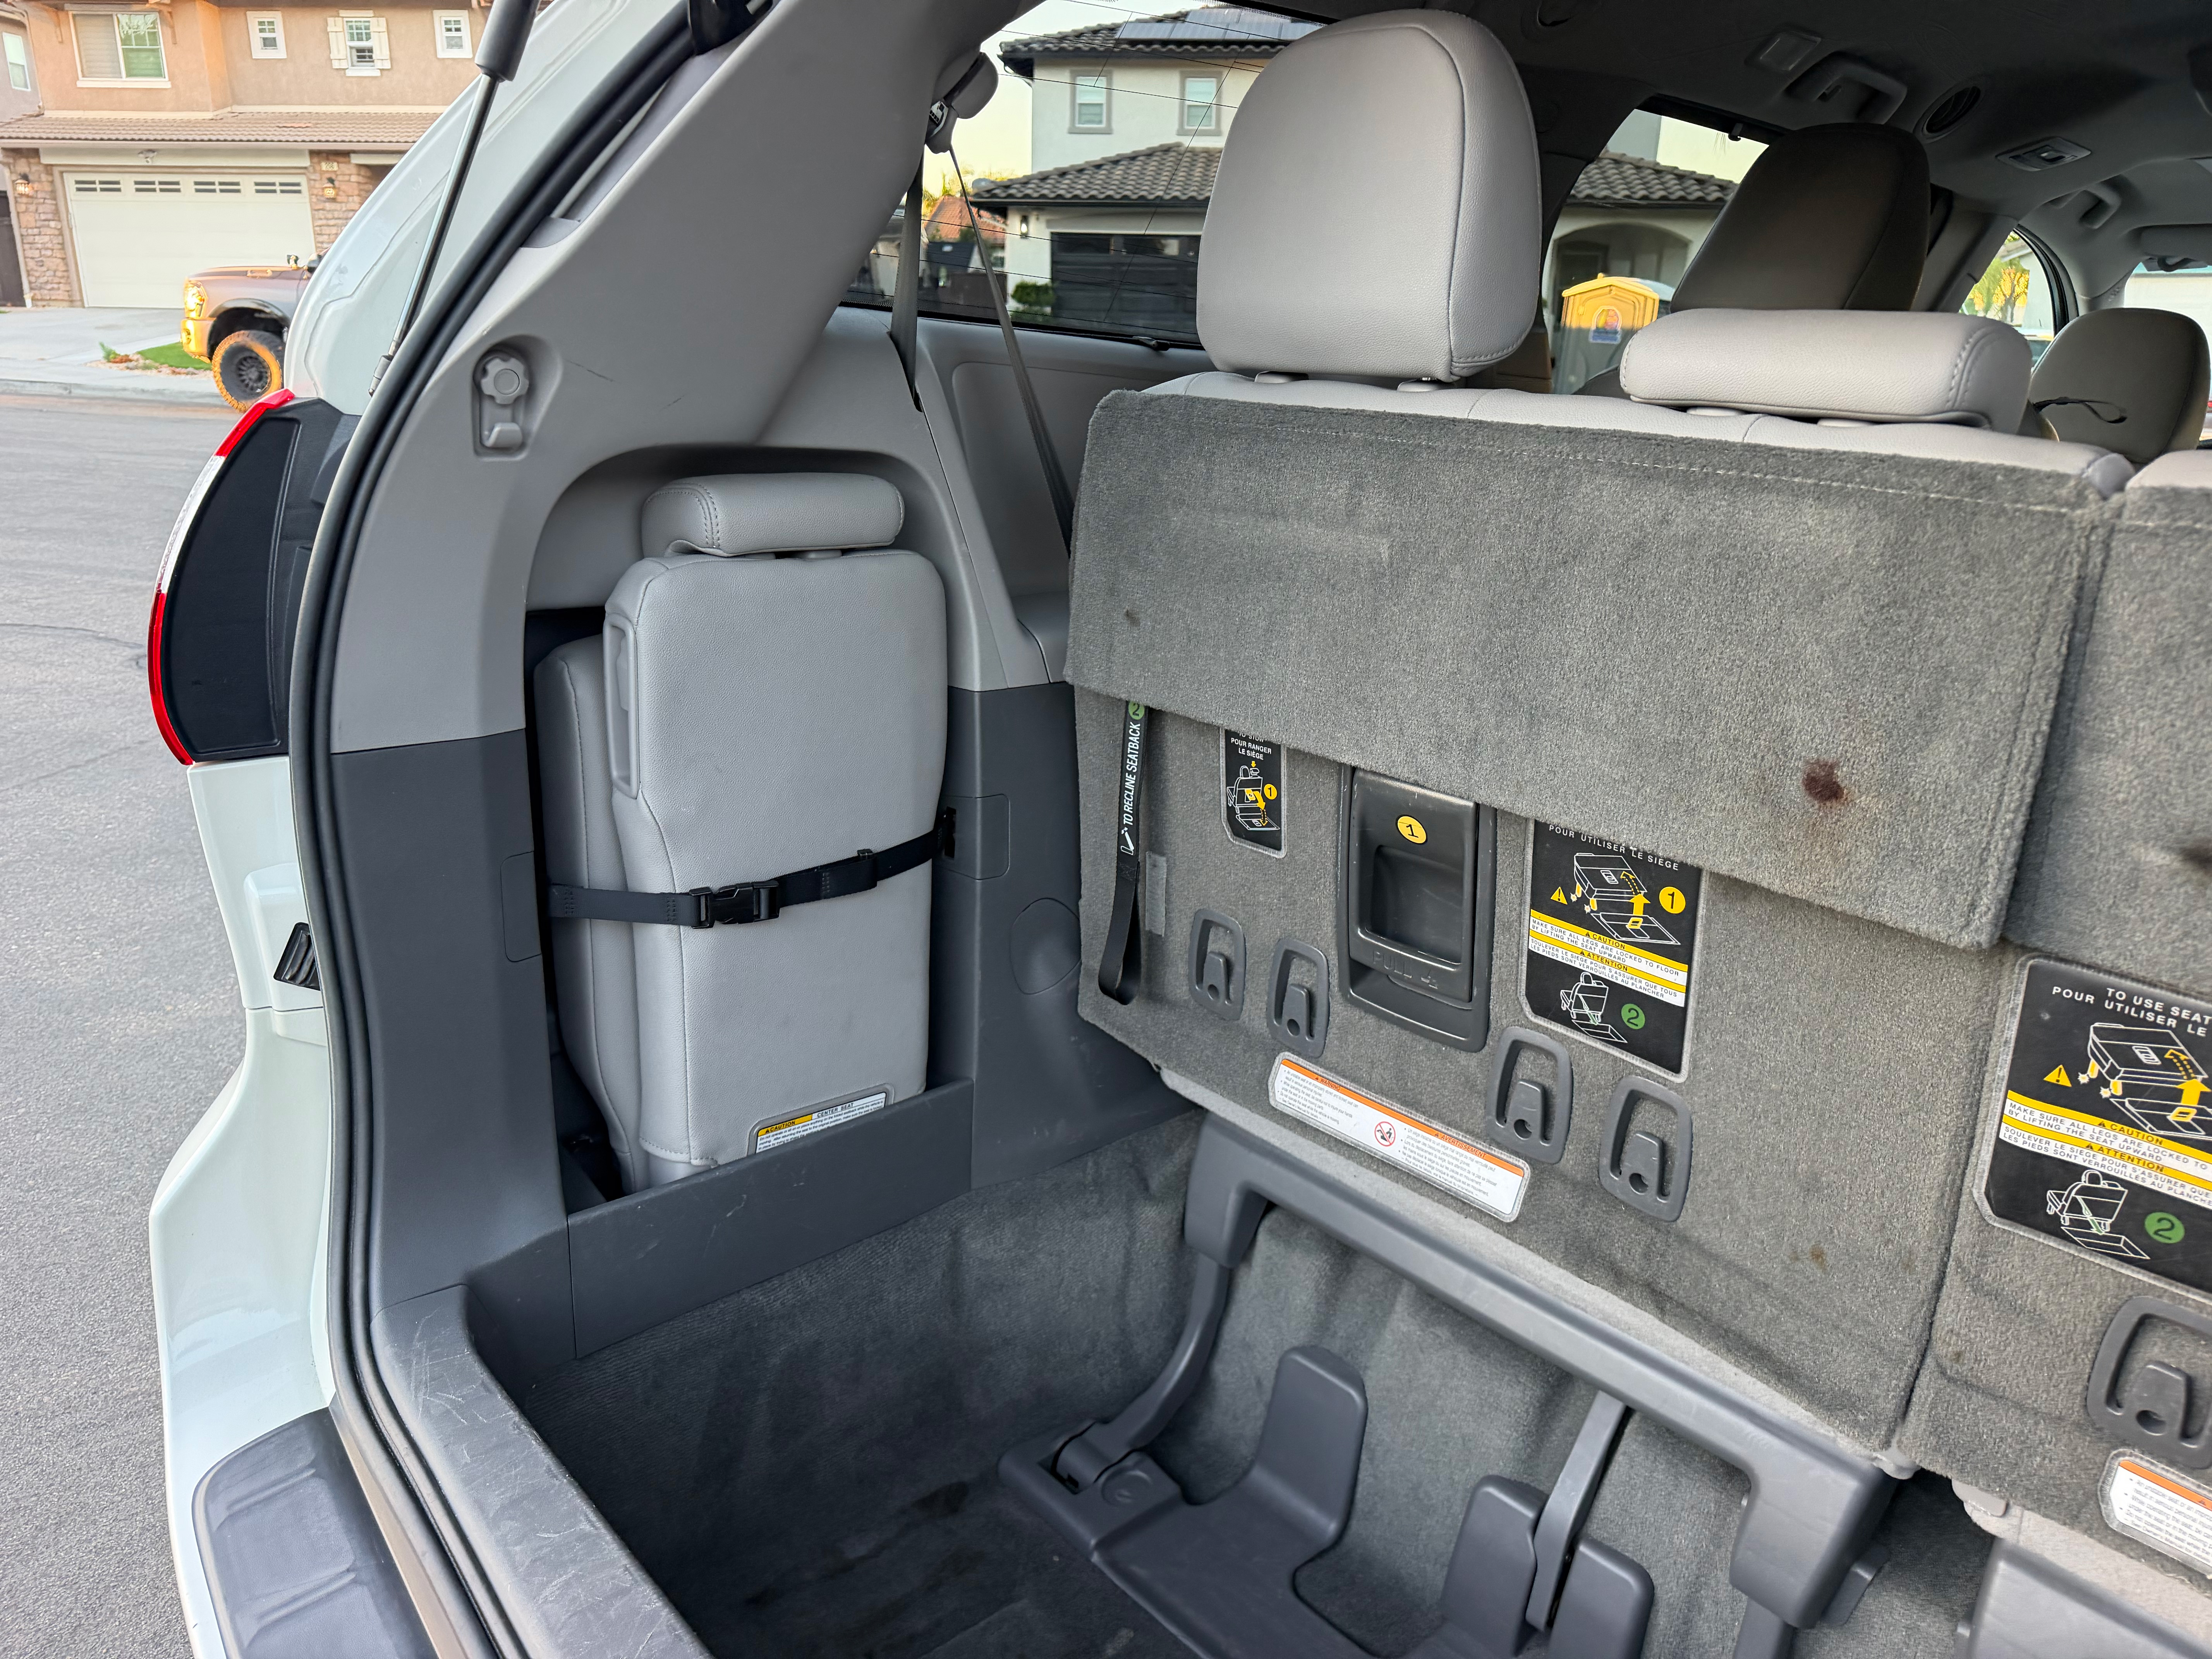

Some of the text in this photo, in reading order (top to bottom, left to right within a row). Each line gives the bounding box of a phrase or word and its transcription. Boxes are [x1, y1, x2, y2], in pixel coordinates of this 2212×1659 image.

[1132, 703, 1140, 717] 2
[1231, 737, 1271, 754] POUR RANGER
[1123, 721, 1140, 826] TO RECLINE SEATBACK
[1267, 787, 1272, 797] 1
[1405, 824, 1419, 839] 1
[1549, 825, 1679, 871] POUR UTILISER LE SIEGE
[1668, 893, 1675, 909] 1
[1532, 919, 1547, 929] MAKE
[1550, 926, 1566, 935] SURE
[1582, 938, 1598, 947] LEGS
[1601, 944, 1613, 953] ARE
[1616, 950, 1642, 963] LOCKED
[1656, 964, 1678, 976] FLOOR
[1541, 928, 1564, 940] LIFTING
[1567, 937, 1578, 945] THE
[1581, 943, 1596, 952] SEAT
[1599, 949, 1625, 963] UPWARD
[1592, 933, 1625, 949] CAUTION
[1531, 938, 1559, 953] SOULEVER
[1590, 961, 1606, 970] POUR
[1645, 981, 1657, 990] QUE
[1661, 987, 1677, 997] TOUS
[1542, 948, 1558, 958] PIEDS
[1561, 955, 1576, 965] SONT
[1631, 982, 1664, 998] PLANCHER
[1587, 952, 1627, 971] ATTENTION
[1627, 1008, 1639, 1025] 2
[2052, 986, 2207, 1037] POUR UTILISER LE
[2107, 988, 2212, 1025] TO USE SEAT
[1320, 1078, 1341, 1091] WARNING
[770, 1120, 795, 1132] CAUTION
[817, 1107, 838, 1117] CENTER
[841, 1102, 853, 1110] SEAT
[1441, 1135, 1487, 1158] AVERTISSEMENT
[2008, 1109, 2162, 1162] BY LIFTING THE SEAT UPWARD
[2009, 1102, 2207, 1171] MAKE SURE ALL LEGS ARE LOCKED TO
[2110, 1123, 2163, 1146] CAUTION
[2003, 1132, 2018, 1143] LES
[2022, 1139, 2049, 1153] PIEDS
[2053, 1148, 2078, 1162] SONT
[2150, 1180, 2163, 1189] AU
[2004, 1126, 2050, 1147] SOULEVER
[2054, 1142, 2065, 1151] LE
[2101, 1156, 2127, 1170] POUR
[2131, 1166, 2186, 1190] S'ASSURER
[2190, 1186, 2210, 1198] QUE
[2097, 1145, 2164, 1173] ATTENTION
[2153, 1220, 2175, 1240] 2
